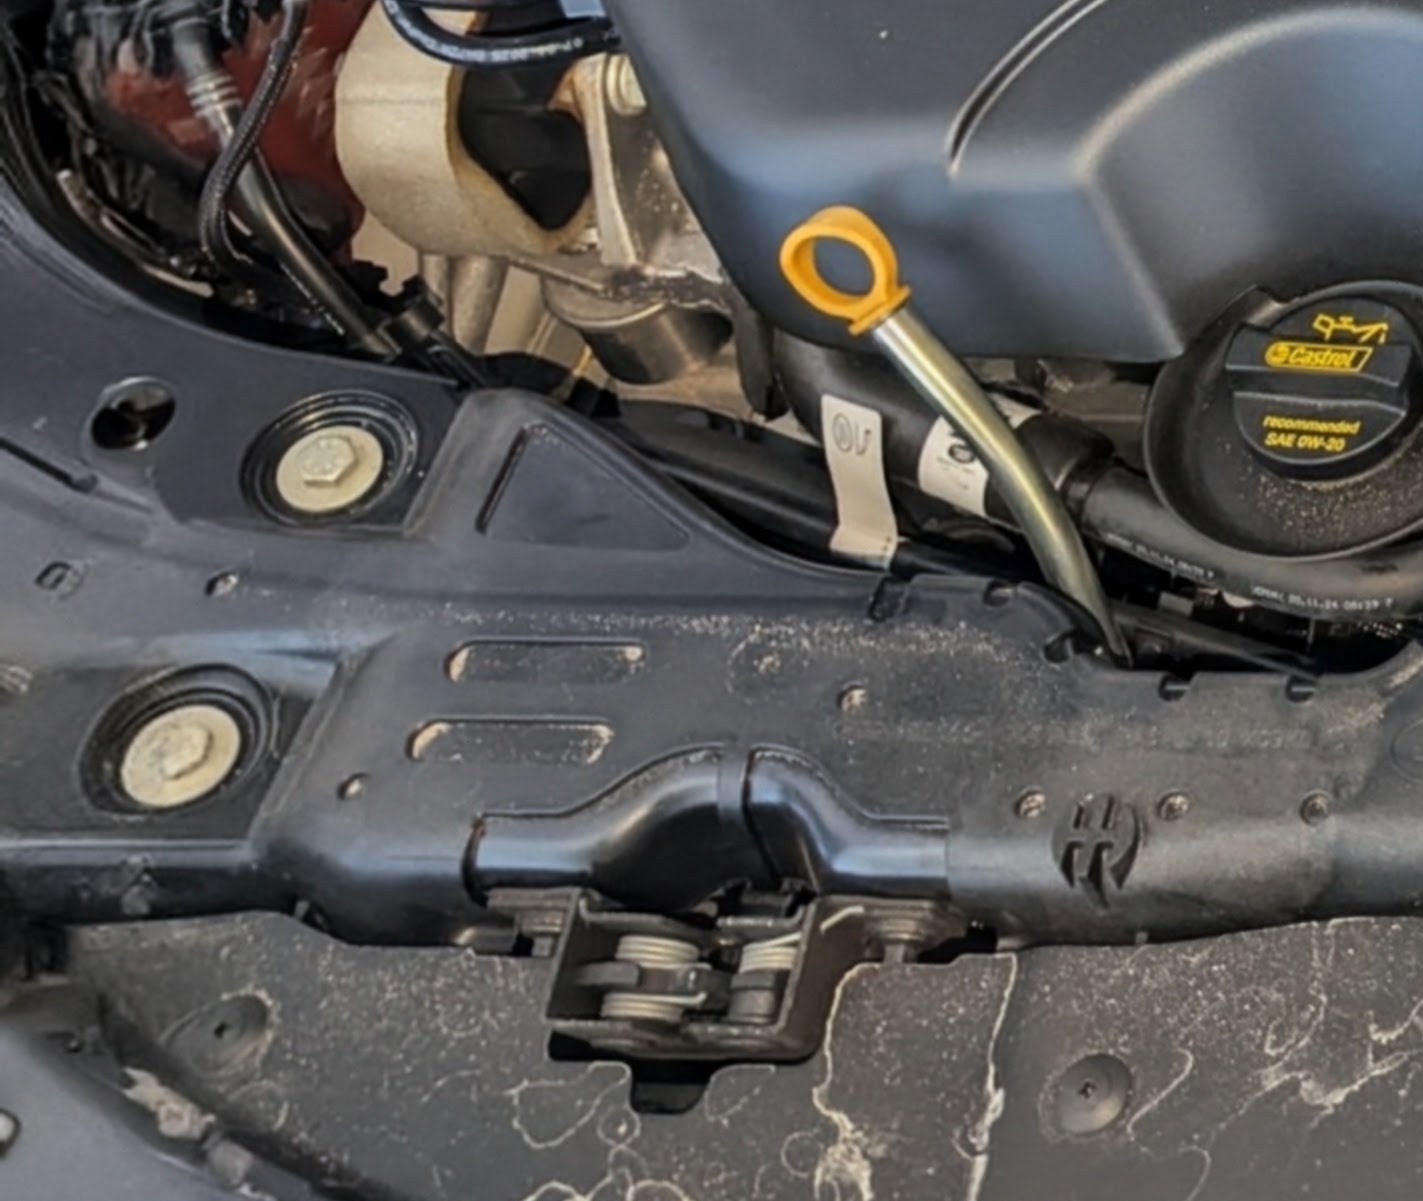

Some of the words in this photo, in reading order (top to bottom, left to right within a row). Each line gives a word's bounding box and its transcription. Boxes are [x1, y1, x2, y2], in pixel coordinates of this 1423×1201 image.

[1289, 346, 1357, 369] Castrol
[1263, 416, 1361, 435] recommended
[1264, 432, 1297, 448] SAE
[1297, 435, 1346, 452] 0W-20
